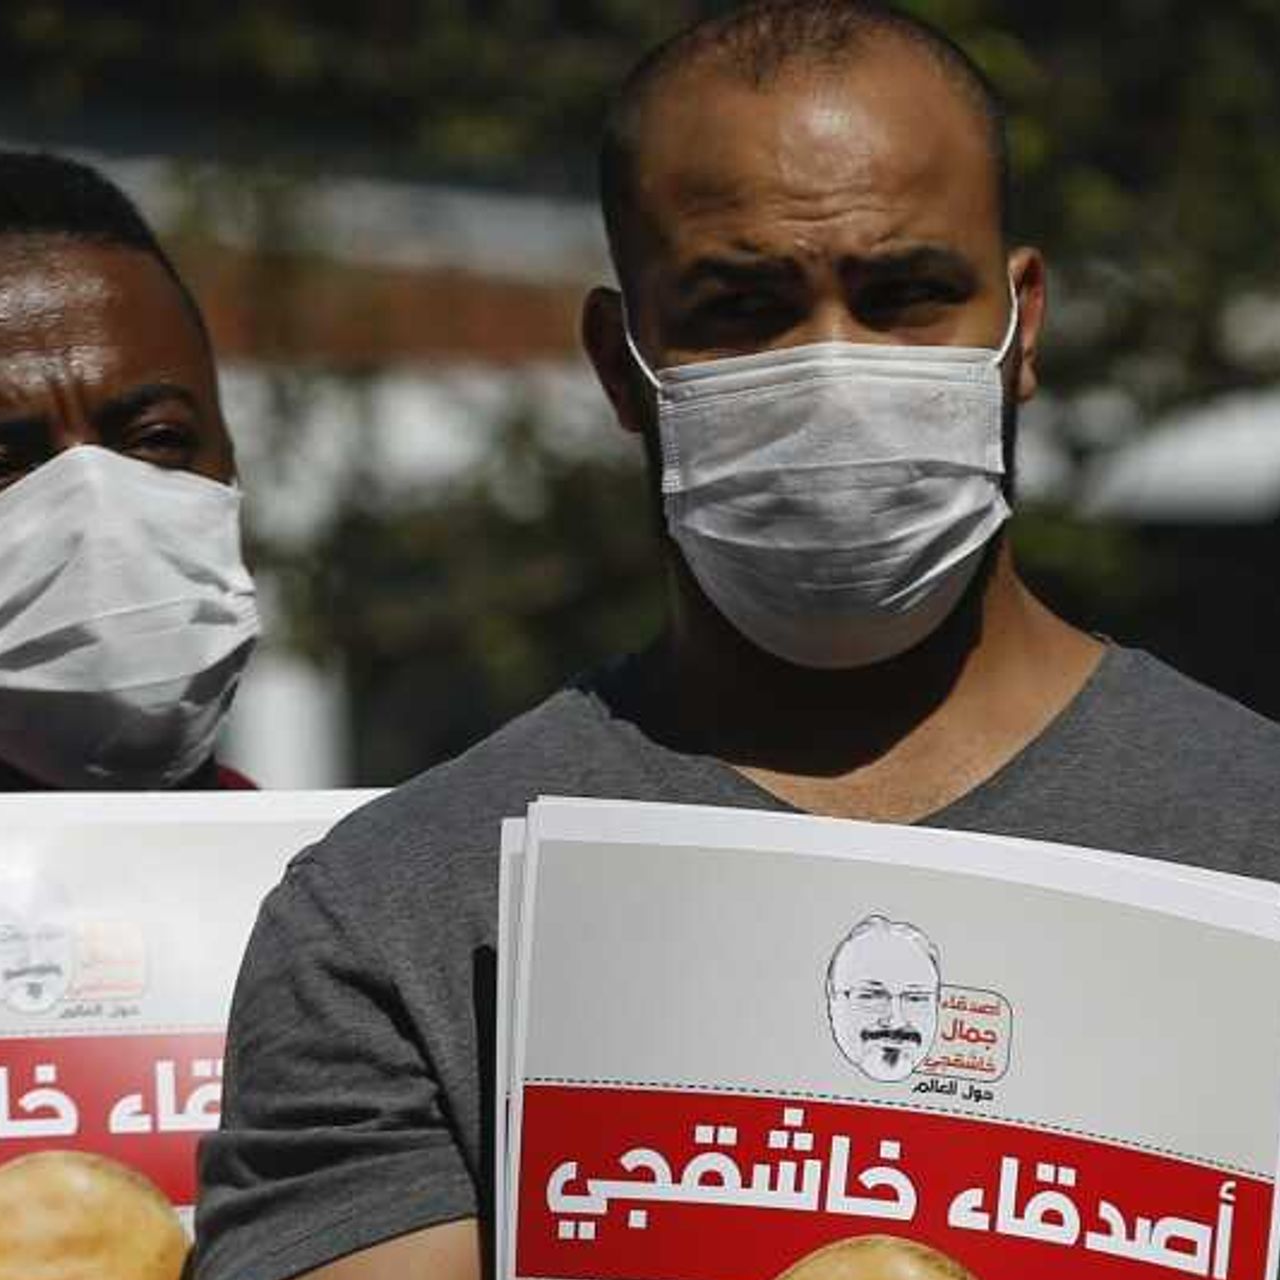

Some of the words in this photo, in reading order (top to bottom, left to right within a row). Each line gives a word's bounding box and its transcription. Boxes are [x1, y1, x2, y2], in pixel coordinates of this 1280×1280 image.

[942, 1018, 998, 1050] جمال
[911, 1079, 958, 1096] العالم
[961, 1085, 994, 1102] حول
[546, 1107, 918, 1240] خاشقجي
